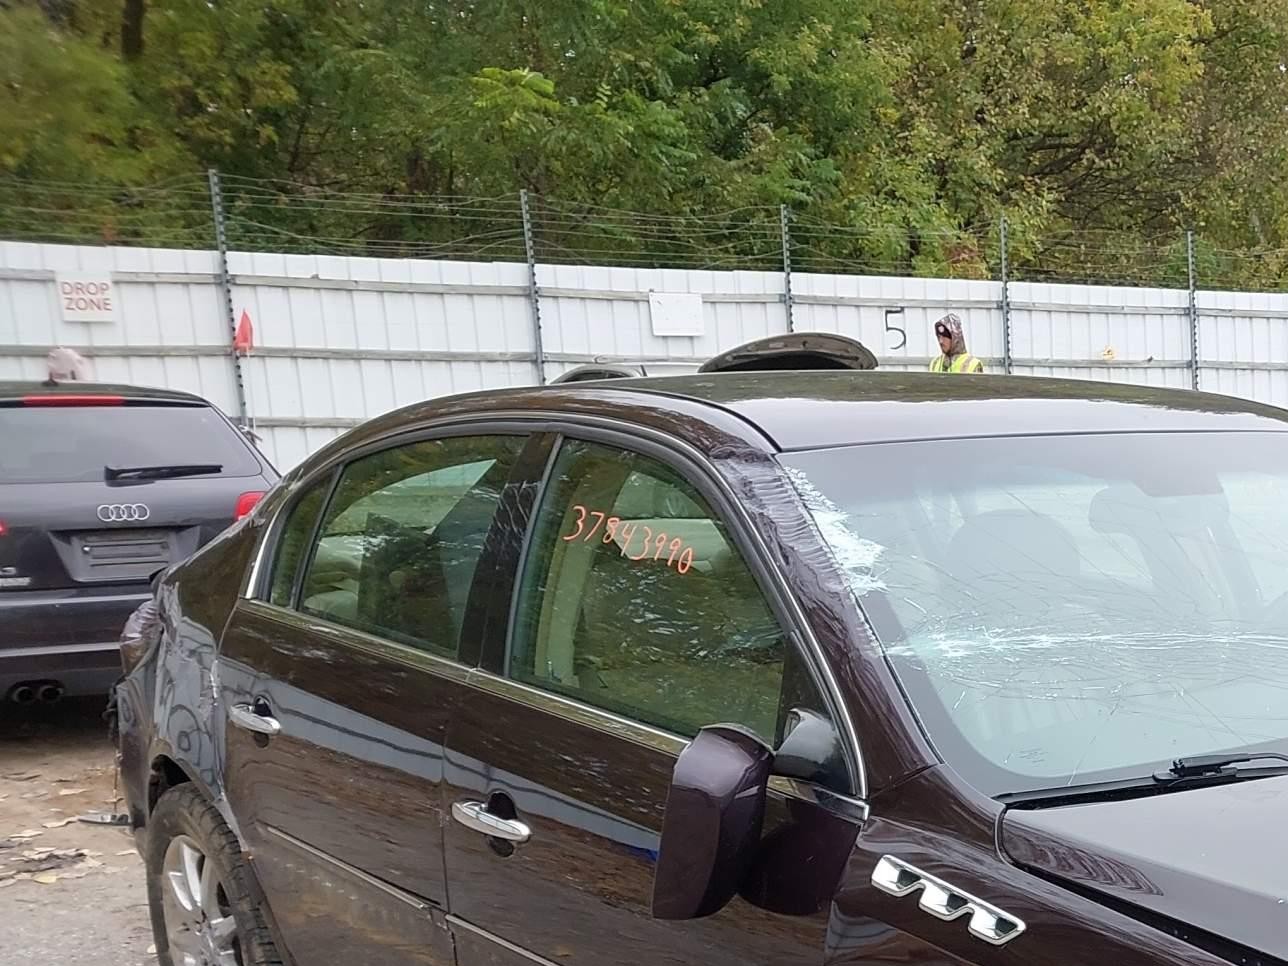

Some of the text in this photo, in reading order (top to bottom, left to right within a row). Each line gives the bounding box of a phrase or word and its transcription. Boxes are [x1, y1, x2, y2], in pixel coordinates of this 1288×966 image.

[61, 281, 110, 296] DROP
[63, 297, 112, 311] ZONE
[884, 306, 907, 350] 5
[562, 505, 693, 574] 37843990
